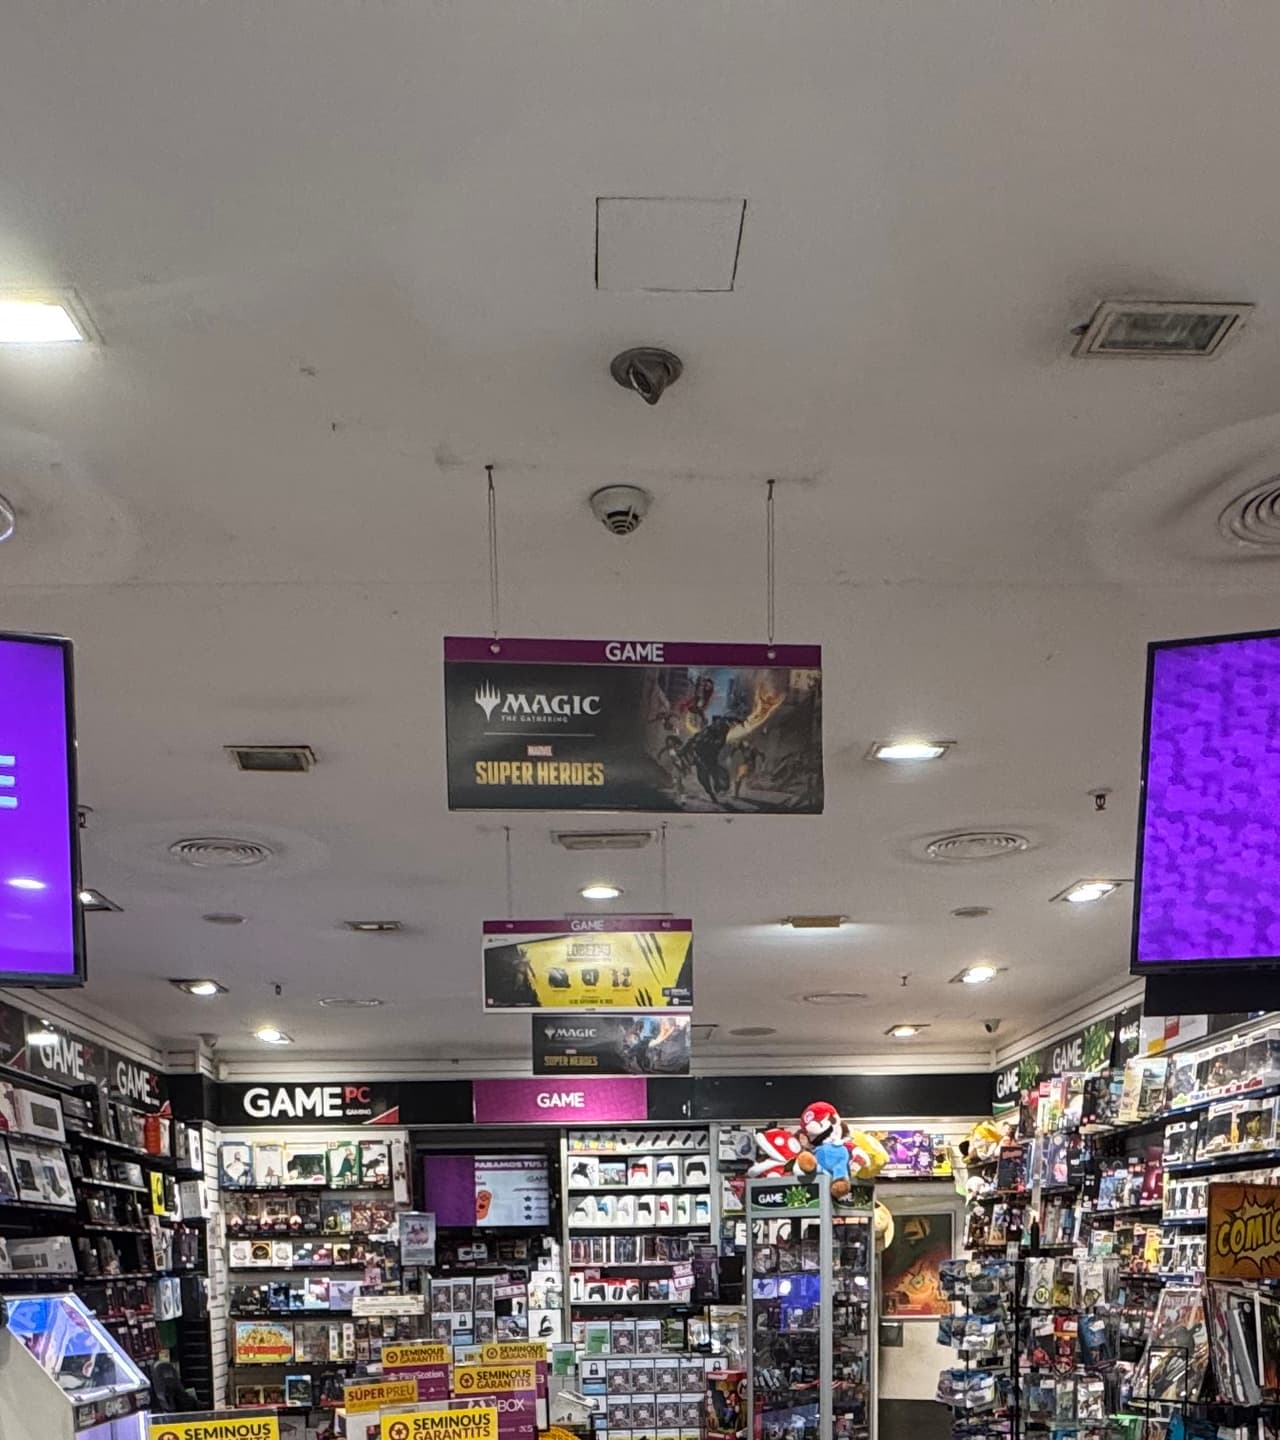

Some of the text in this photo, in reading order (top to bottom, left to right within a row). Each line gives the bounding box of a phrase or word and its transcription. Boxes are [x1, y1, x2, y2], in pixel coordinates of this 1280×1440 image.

[605, 642, 664, 662] GAME
[502, 694, 600, 716] MAGIC
[475, 762, 605, 786] SUPER HEROES
[571, 920, 604, 931] GAME
[556, 1028, 597, 1038] MAGIC
[39, 1033, 86, 1079] GAME
[1053, 1039, 1083, 1073] GAME
[117, 1060, 151, 1103] GAME
[996, 1069, 1019, 1099] GAME
[243, 1086, 370, 1118] GAME PC
[537, 1092, 585, 1108] GAME
[758, 1192, 783, 1204] GAME
[400, 1347, 444, 1358] SEMINOUS
[477, 1369, 531, 1382] SEMINOUS
[477, 1377, 531, 1389] GARANTITS
[349, 1384, 415, 1401] SÚPER PREU
[413, 1413, 491, 1431] SEMINOUS
[184, 1423, 271, 1440] SEMINOUS
